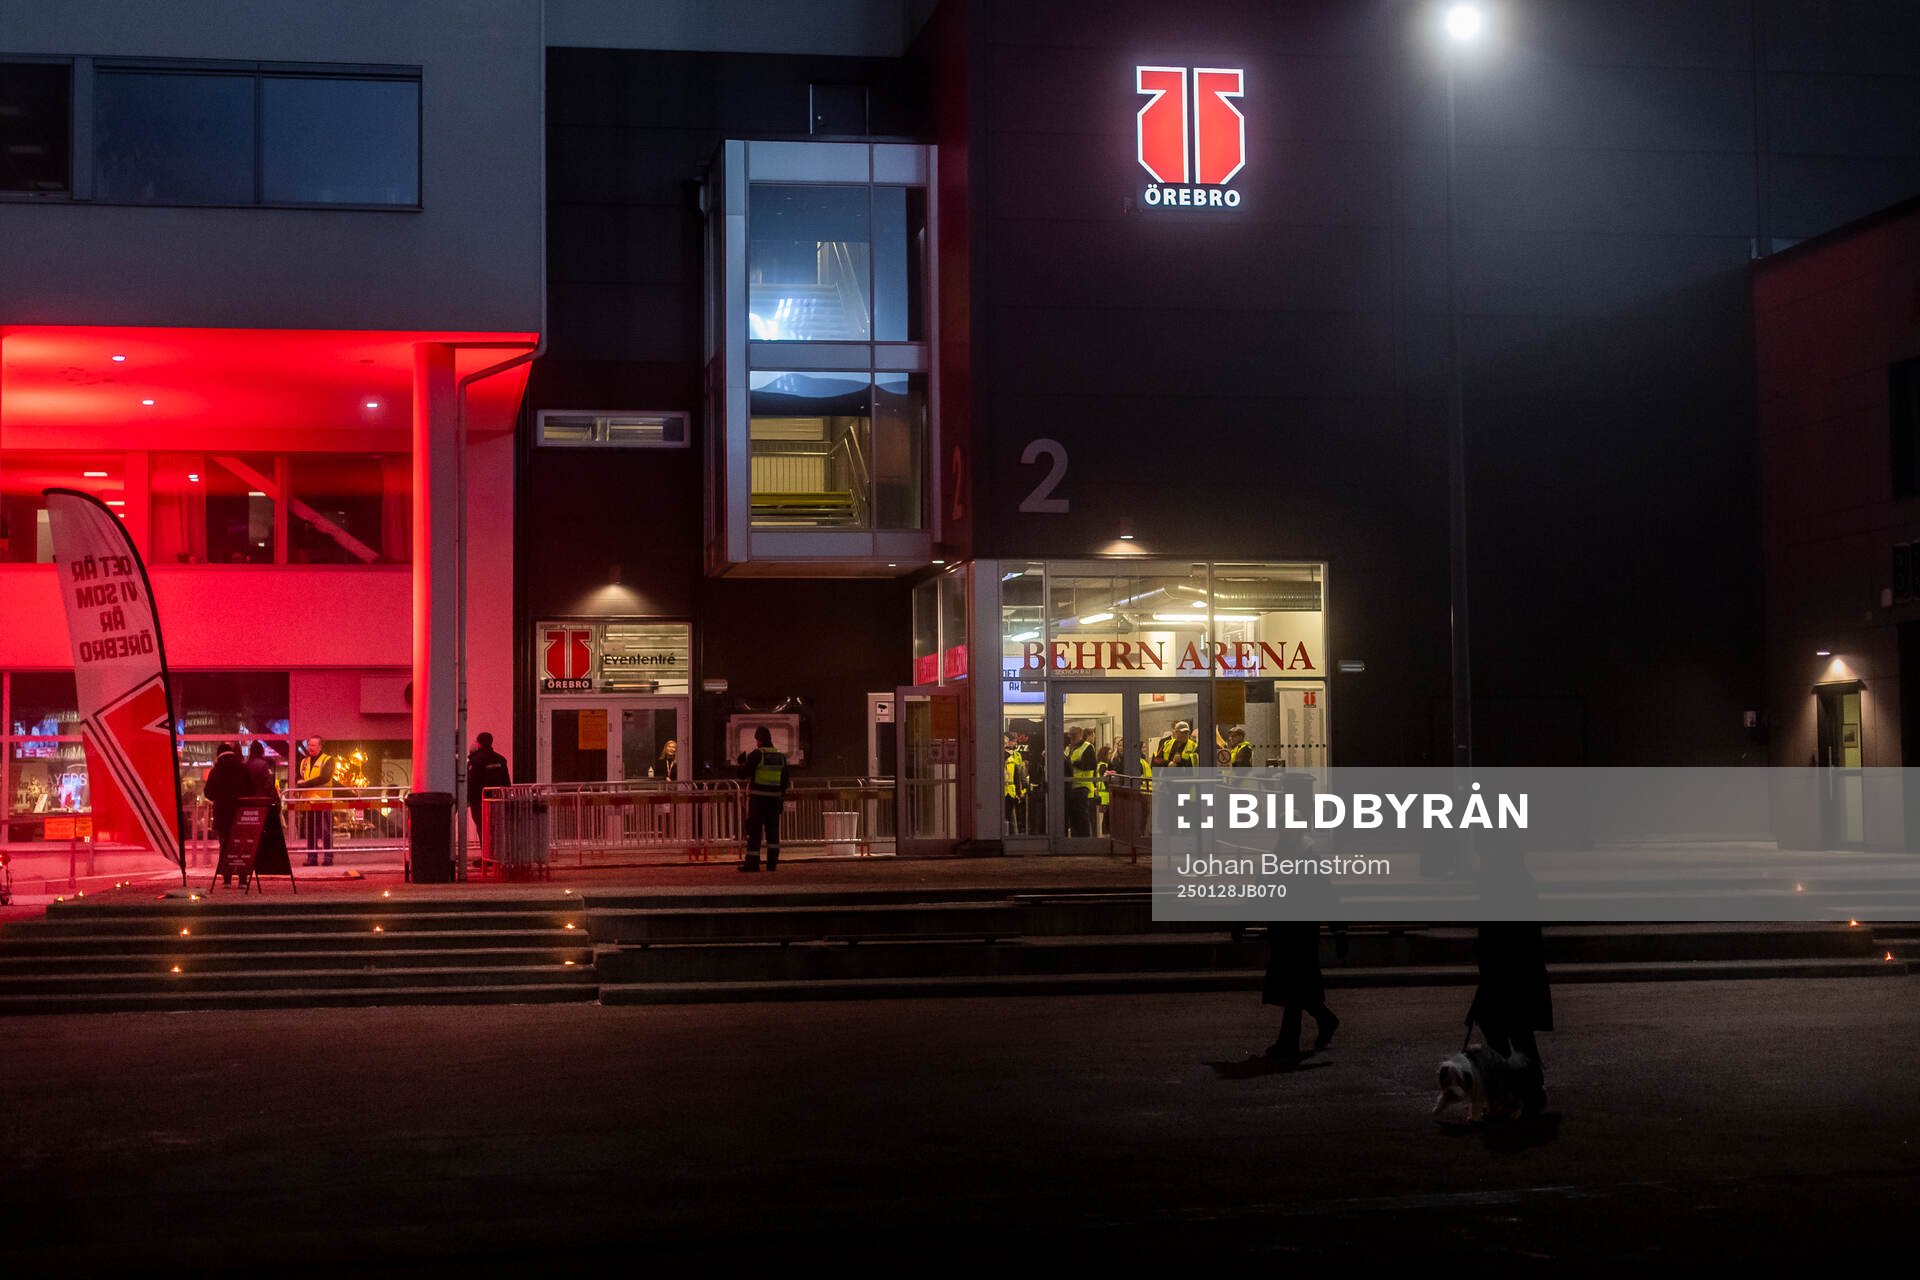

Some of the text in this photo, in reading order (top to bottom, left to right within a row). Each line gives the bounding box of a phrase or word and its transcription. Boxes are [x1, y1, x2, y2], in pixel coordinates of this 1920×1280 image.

[1144, 184, 1241, 207] ÖREBRO
[1019, 438, 1070, 513] 2
[604, 652, 676, 665] Evententré
[1022, 640, 1316, 671] BEHRN ARENA
[547, 680, 590, 689] ÖREBRO
